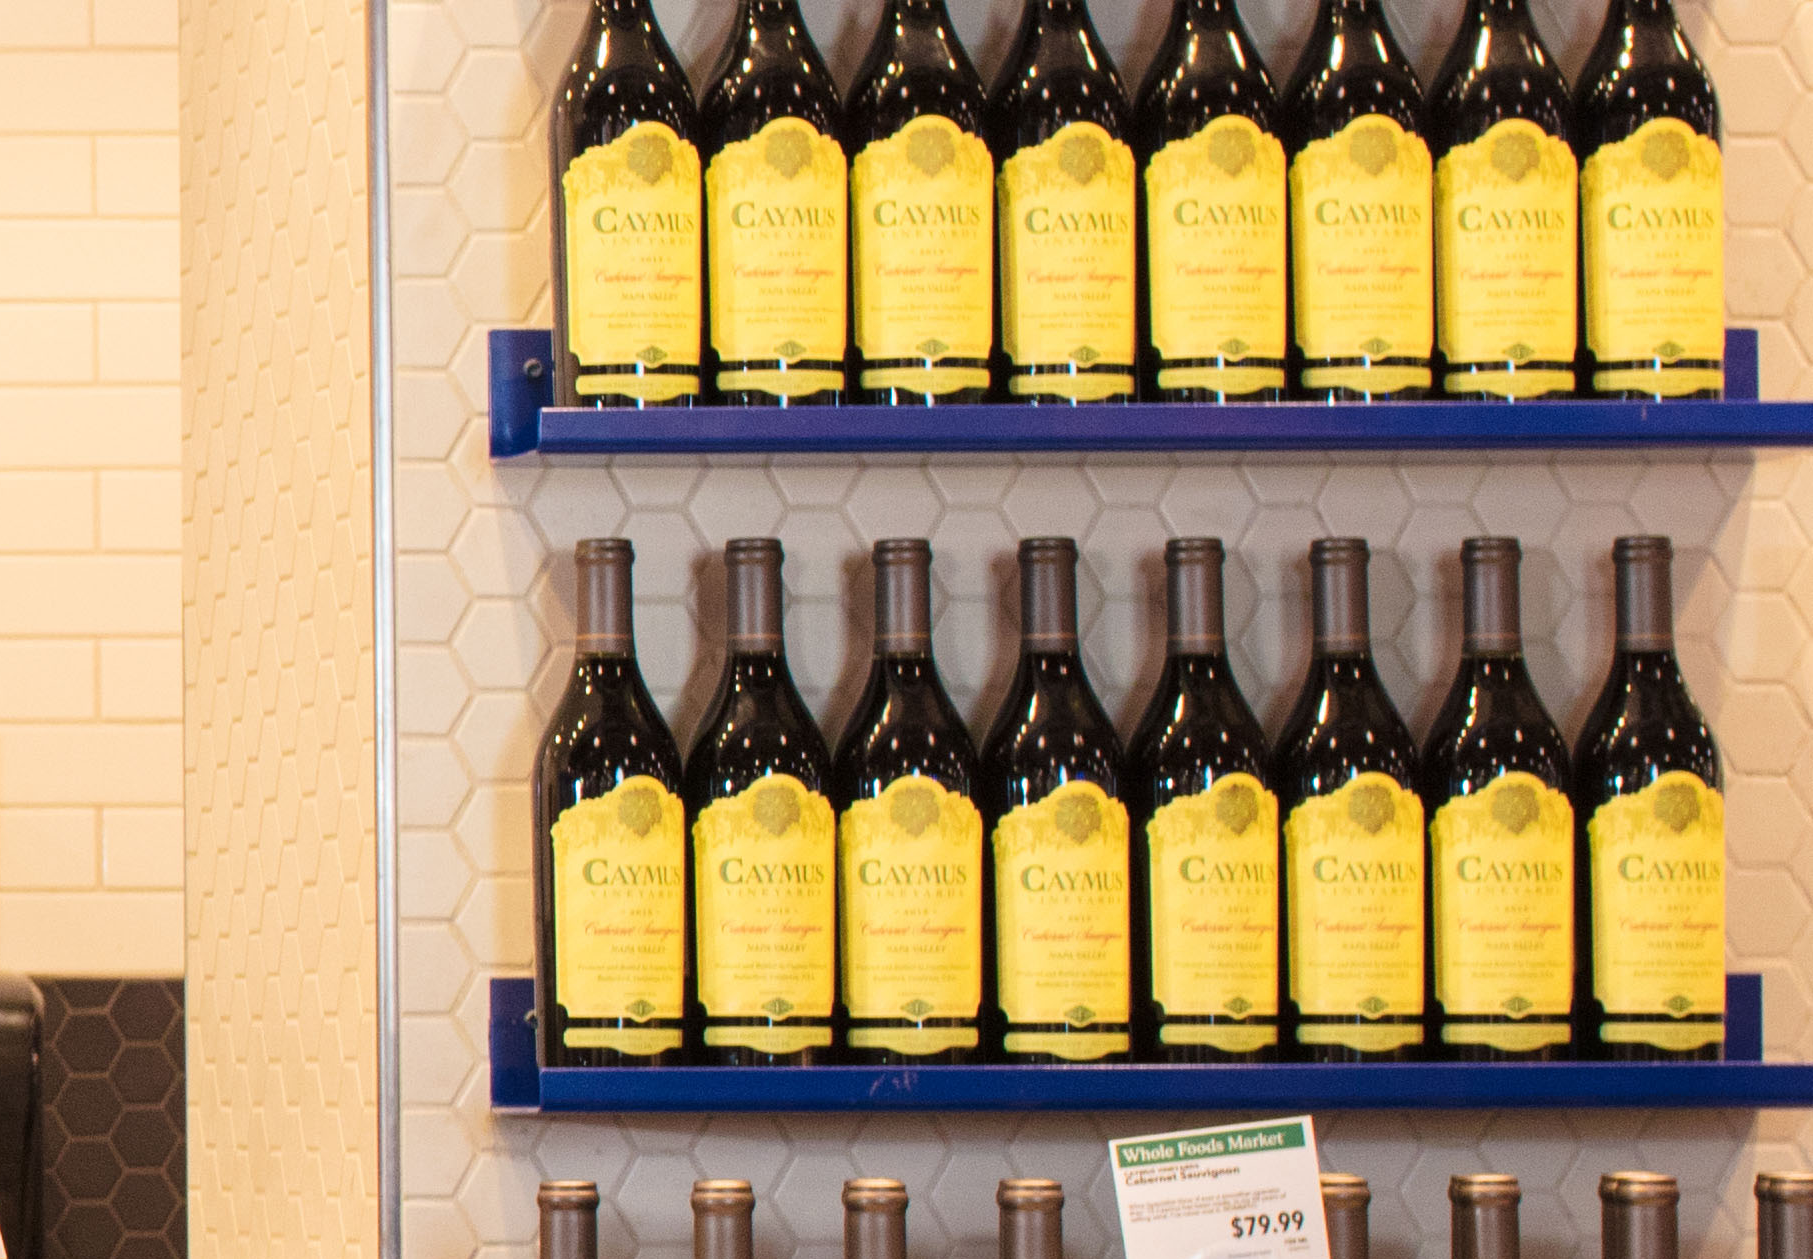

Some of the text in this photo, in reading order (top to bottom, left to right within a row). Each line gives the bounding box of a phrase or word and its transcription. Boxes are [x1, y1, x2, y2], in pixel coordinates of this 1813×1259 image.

[873, 201, 984, 230] CAYMUS
[1174, 199, 1281, 229] CAYMUS
[1314, 201, 1424, 230] CAYMUS
[1457, 201, 1565, 232] CAYMUS
[858, 856, 968, 888] CAYMUS
[1312, 854, 1418, 886] CAYMUS
[1456, 854, 1562, 886] CAYMUS
[1123, 1132, 1284, 1163] Whole Foods Market
[1125, 1166, 1240, 1187] Cabernet Sauvignon
[1232, 1210, 1304, 1239] $79.99
